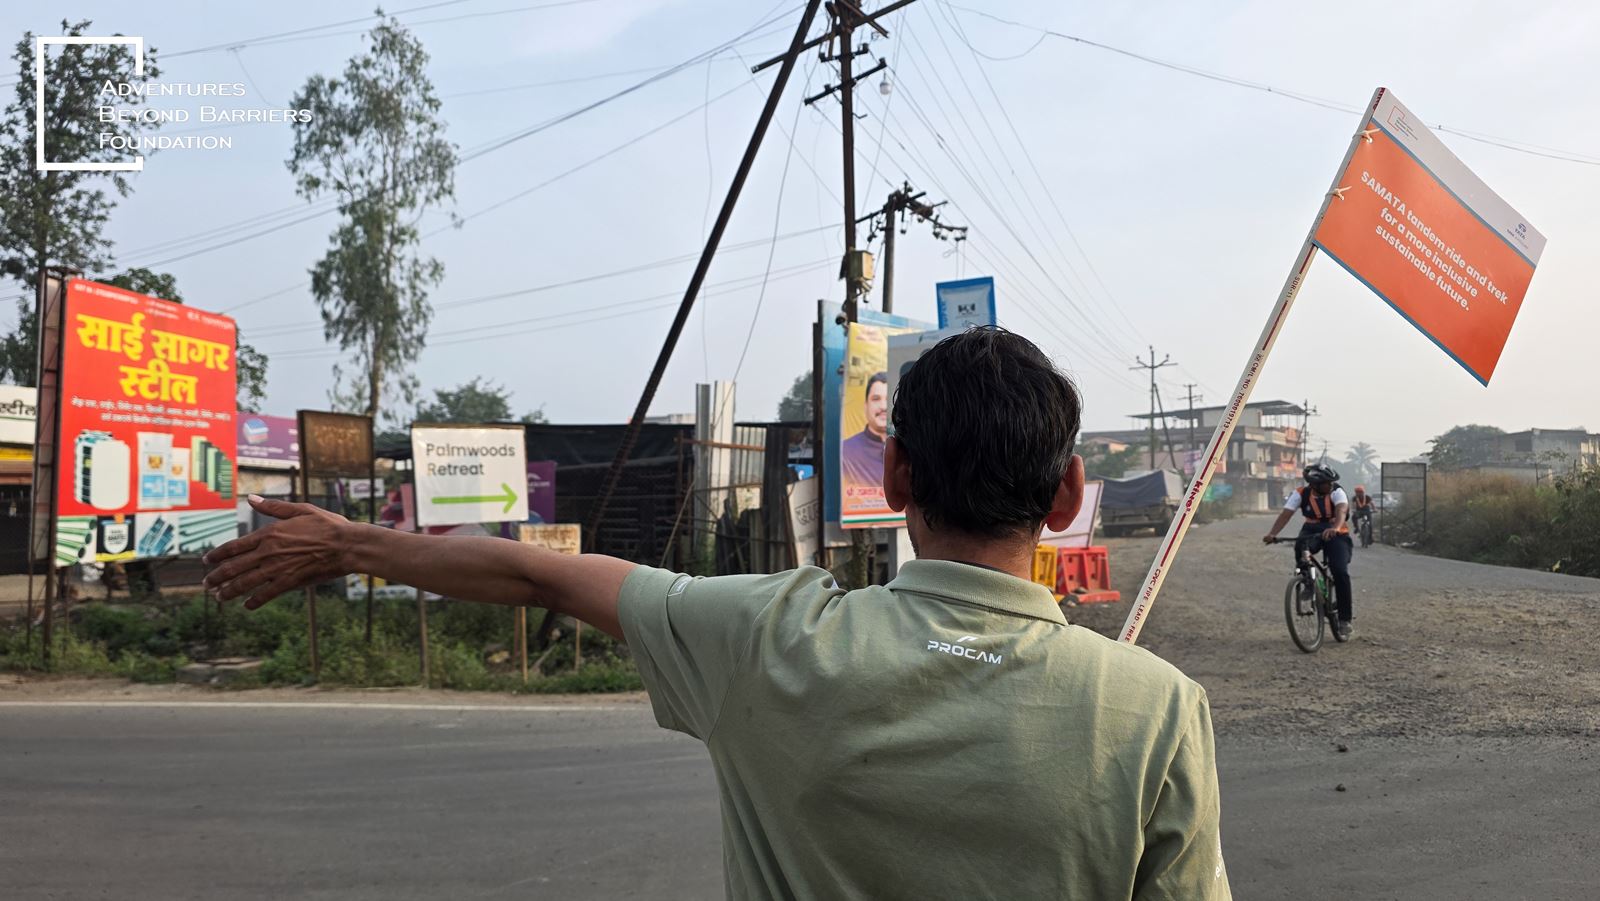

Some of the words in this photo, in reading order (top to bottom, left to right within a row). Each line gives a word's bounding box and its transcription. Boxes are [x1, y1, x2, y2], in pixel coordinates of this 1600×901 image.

[1361, 171, 1406, 216] SAMATA
[1406, 210, 1446, 252] tandem
[1445, 247, 1466, 269] ride
[1466, 265, 1488, 287] and
[1487, 280, 1508, 305] trek
[1380, 207, 1398, 226] for
[1397, 223, 1406, 234] a
[1405, 229, 1433, 258] more
[1431, 251, 1478, 297] inclusive
[1375, 225, 1436, 281] sustainable
[1435, 275, 1469, 311] future.
[76, 311, 145, 361] साई
[151, 329, 230, 371] सागर
[119, 358, 198, 404] स्टील
[425, 443, 515, 457] Palmwoods
[427, 463, 484, 476] Retreat
[927, 640, 1002, 664] PROCAM
